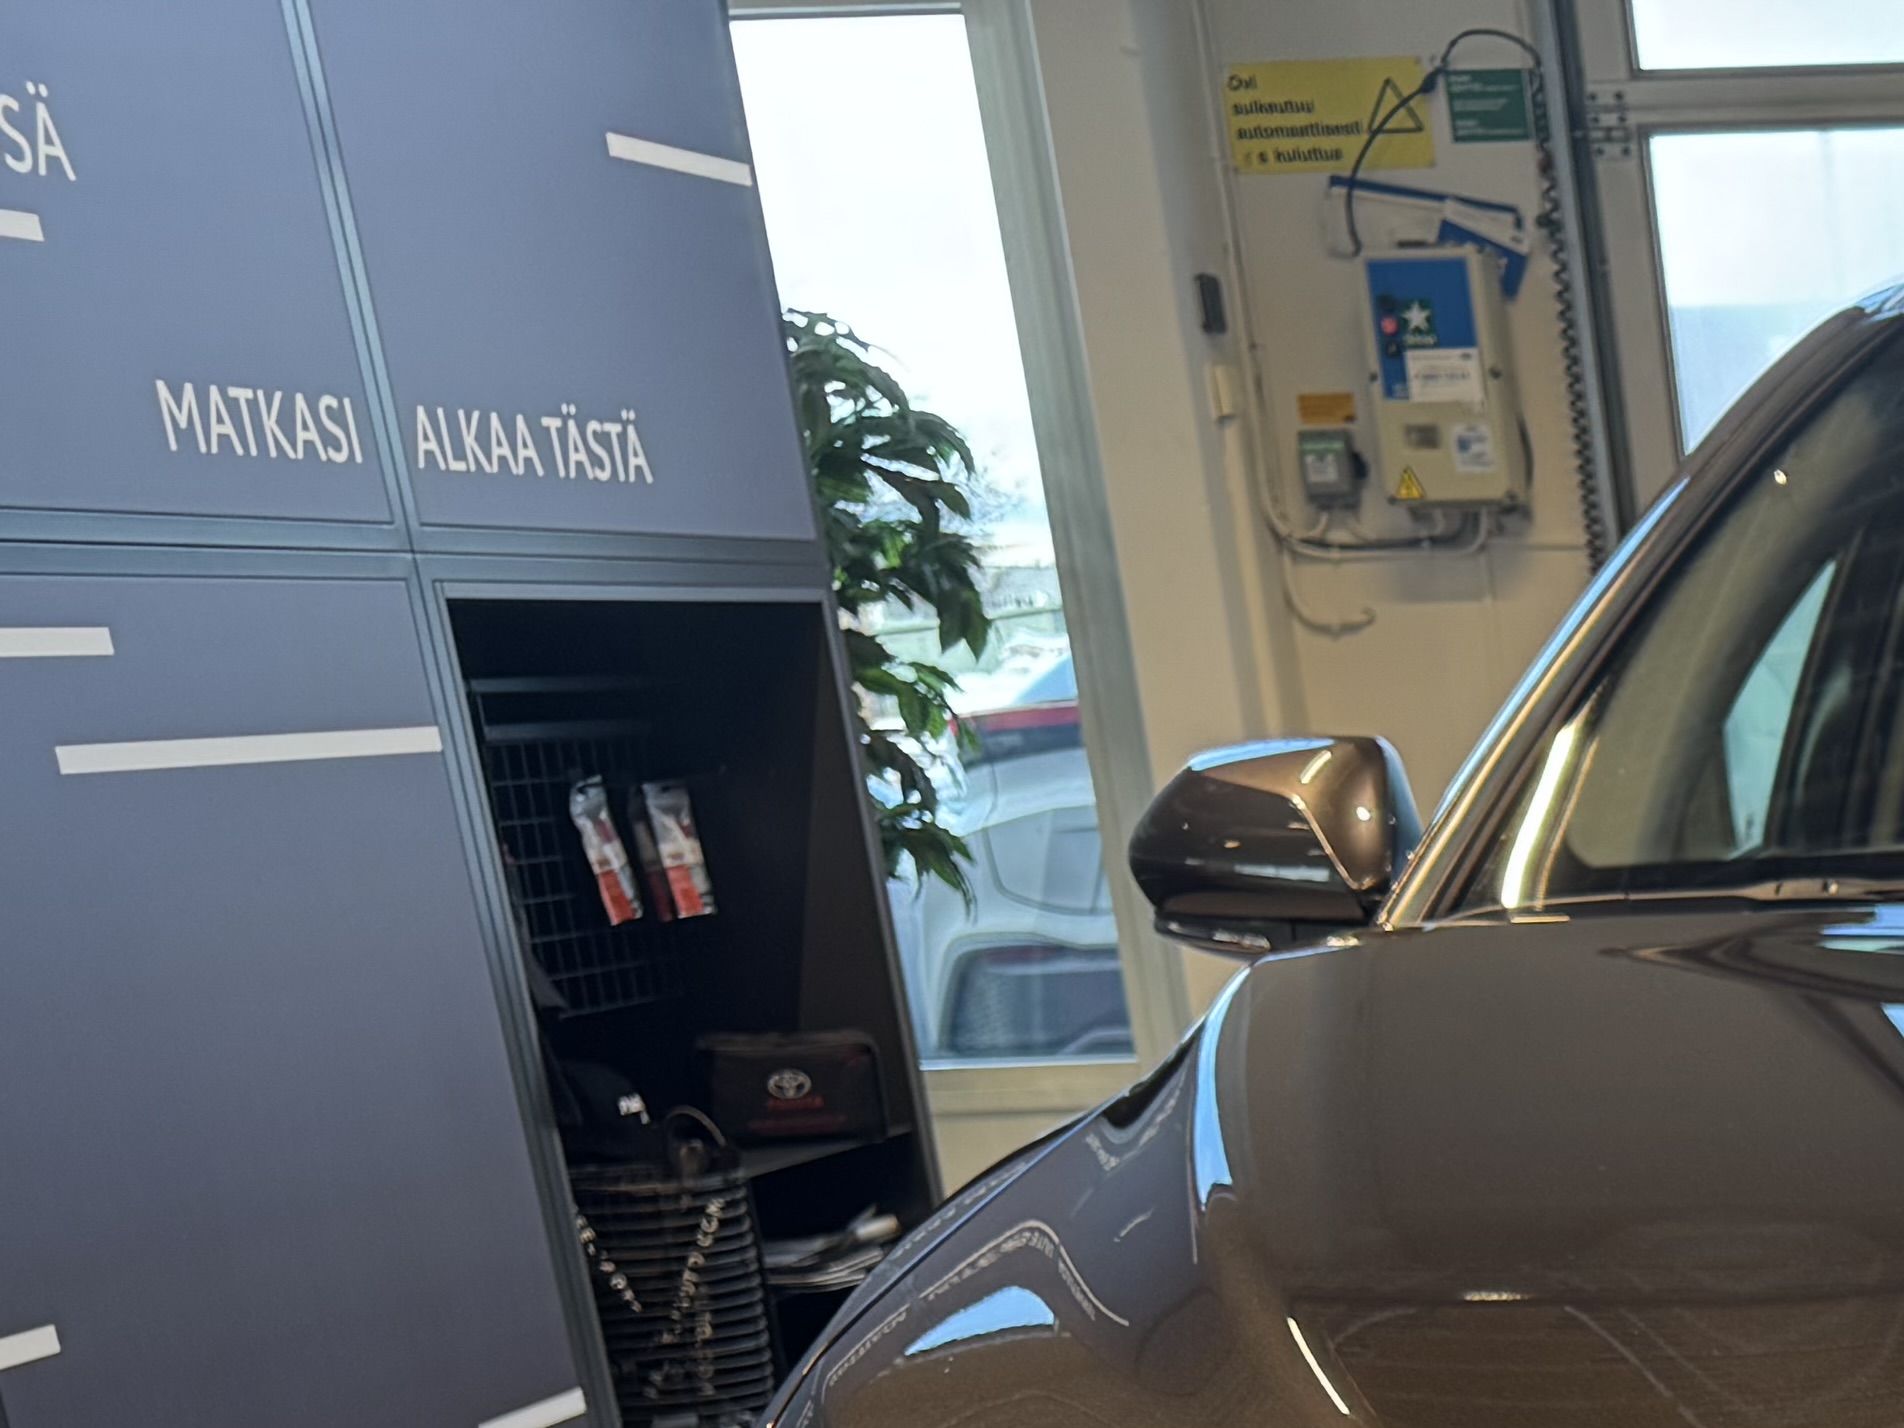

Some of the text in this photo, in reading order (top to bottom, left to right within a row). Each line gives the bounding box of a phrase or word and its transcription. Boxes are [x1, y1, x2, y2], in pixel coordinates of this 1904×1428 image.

[155, 379, 654, 486] MATKASI ALKAA TÄSTÄ
